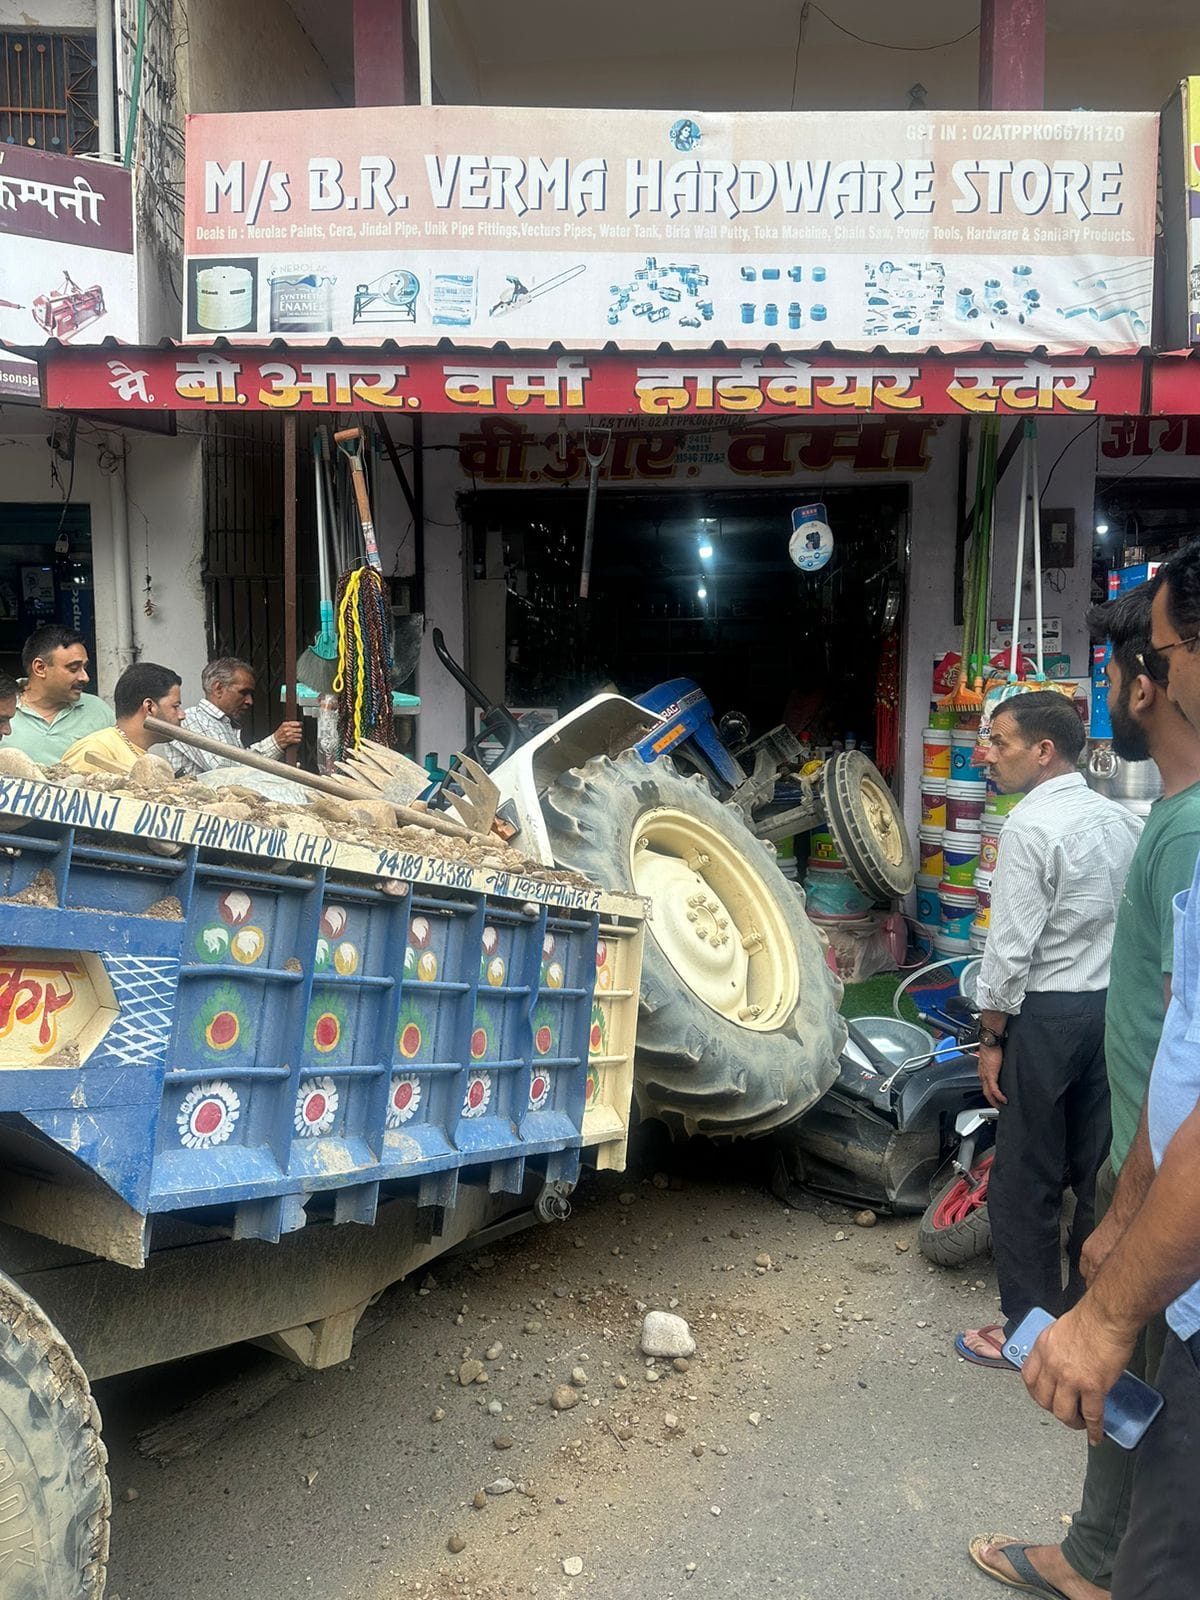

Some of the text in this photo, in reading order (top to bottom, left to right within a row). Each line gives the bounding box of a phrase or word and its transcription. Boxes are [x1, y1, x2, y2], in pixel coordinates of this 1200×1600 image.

[905, 123, 935, 142] GST
[940, 123, 957, 142] IN
[308, 157, 409, 217] B.R.
[424, 155, 608, 217] VERMA
[625, 157, 936, 220] HARDWARE
[951, 158, 1124, 221] STORE
[196, 226, 225, 240] Deals
[228, 226, 238, 240] in
[248, 225, 287, 239] Nerolac
[290, 224, 326, 240] Paints,
[329, 223, 356, 239] Cera,
[359, 222, 392, 237] Jindal
[395, 222, 421, 238] Pipe,
[424, 221, 448, 235] Unik
[452, 222, 475, 238] Pipe
[564, 223, 596, 240] Pipes,
[599, 224, 631, 239] Water
[634, 224, 662, 240] Tank,
[665, 224, 690, 239] Birla
[694, 225, 718, 239] Wall
[721, 225, 750, 242] Putty,
[754, 225, 778, 239] Toka
[782, 225, 832, 242] Machine,
[834, 225, 866, 239] Chain
[868, 226, 894, 241] Saw,
[897, 226, 930, 240] Power
[932, 226, 963, 242] Tools,
[967, 226, 1018, 241] Hardware
[1021, 227, 1030, 241] &
[1033, 226, 1081, 243] Sanitary
[1083, 227, 1136, 243] Products.
[442, 355, 592, 408] वर्मा
[634, 357, 923, 414] हार्डवेयर
[946, 358, 1098, 414] स्टोर
[190, 813, 287, 857] HAMIRPUR
